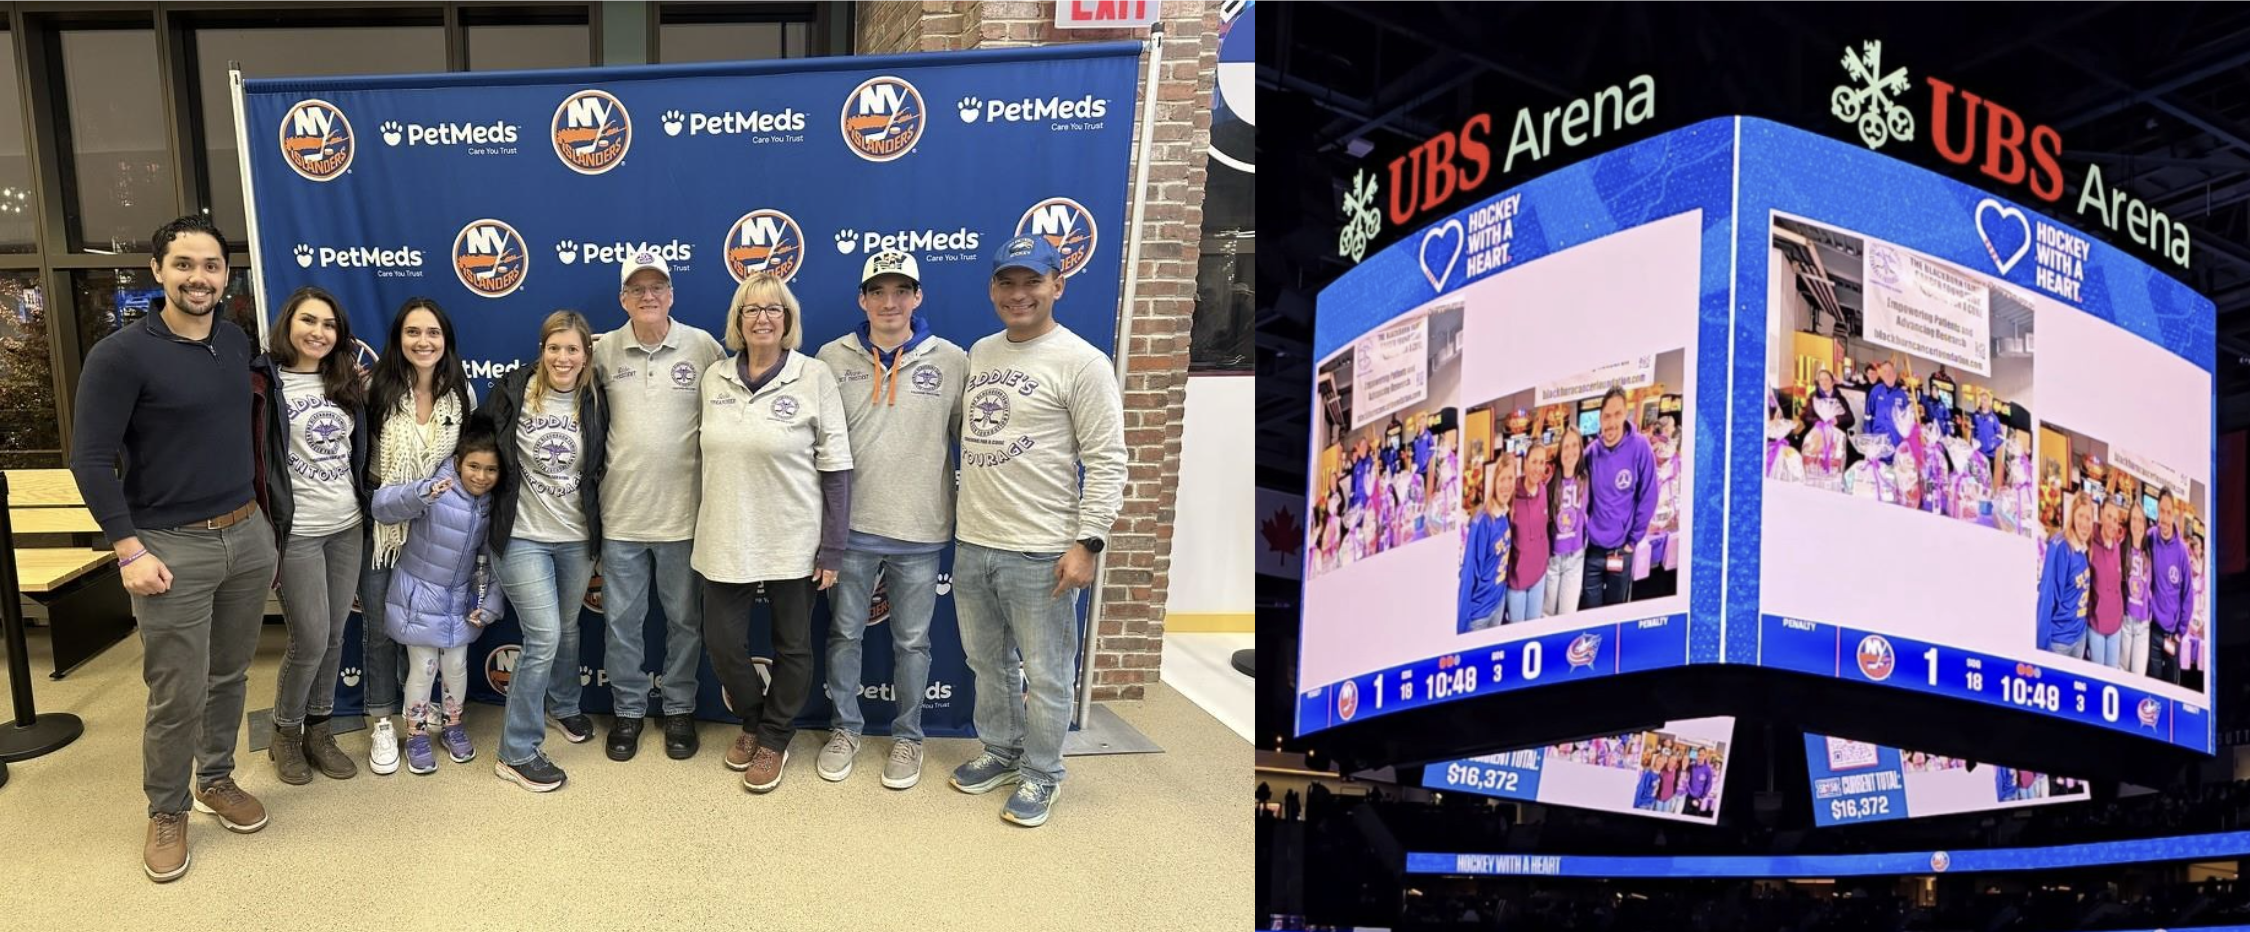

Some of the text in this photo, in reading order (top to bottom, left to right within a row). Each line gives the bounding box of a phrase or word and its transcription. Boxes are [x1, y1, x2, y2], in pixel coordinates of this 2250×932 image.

[568, 97, 613, 127] NY
[860, 84, 907, 114] NY
[987, 95, 1107, 122] PetMeds
[293, 106, 335, 136] NY
[407, 121, 518, 145] PetMeds
[690, 108, 806, 135] PetMeds
[1051, 122, 1104, 131] Care You Trust
[468, 147, 485, 155] Care
[486, 147, 499, 155] You
[562, 137, 622, 168] ISLANDERS
[752, 136, 770, 144] Care
[771, 135, 784, 143] You
[851, 124, 915, 155] ISLANDERS
[1388, 74, 1655, 225] UBS Arena
[289, 145, 346, 174] ISLANDERS
[1926, 76, 2191, 270] UBS Arena
[1032, 205, 1079, 235] NY
[1468, 193, 1521, 232] HOCKEY
[466, 227, 511, 254] NY
[741, 216, 788, 246] NY
[864, 228, 979, 253] PetMeds
[1467, 222, 1514, 251] WITH A
[2036, 221, 2090, 262] HOCKEY
[319, 246, 422, 267] PetMeds
[2036, 242, 2085, 281] WITH A
[461, 263, 520, 291] ISLANDERS
[1887, 297, 1933, 325] Empowering
[1934, 314, 1961, 333] Patients
[1896, 315, 1967, 348] Advancing Research
[1638, 616, 1670, 630] PENALTY
[1782, 617, 1817, 632] PENALTY
[1493, 664, 1503, 682] 3
[1522, 640, 1542, 680] 0
[1924, 647, 1938, 686] 1
[1373, 674, 1383, 709] 1
[1400, 682, 1413, 700] 18
[1426, 666, 1477, 700] 10:48
[1965, 671, 1983, 692] 18
[2001, 676, 2060, 712] 10:48
[2076, 695, 2085, 712] 3
[2102, 685, 2120, 722] 0
[1447, 762, 1518, 791] $16,372
[1841, 772, 1876, 795] CURRENT
[1831, 796, 1890, 820] $16,372
[1457, 854, 1561, 875] HOCKEY WITH A HEART
